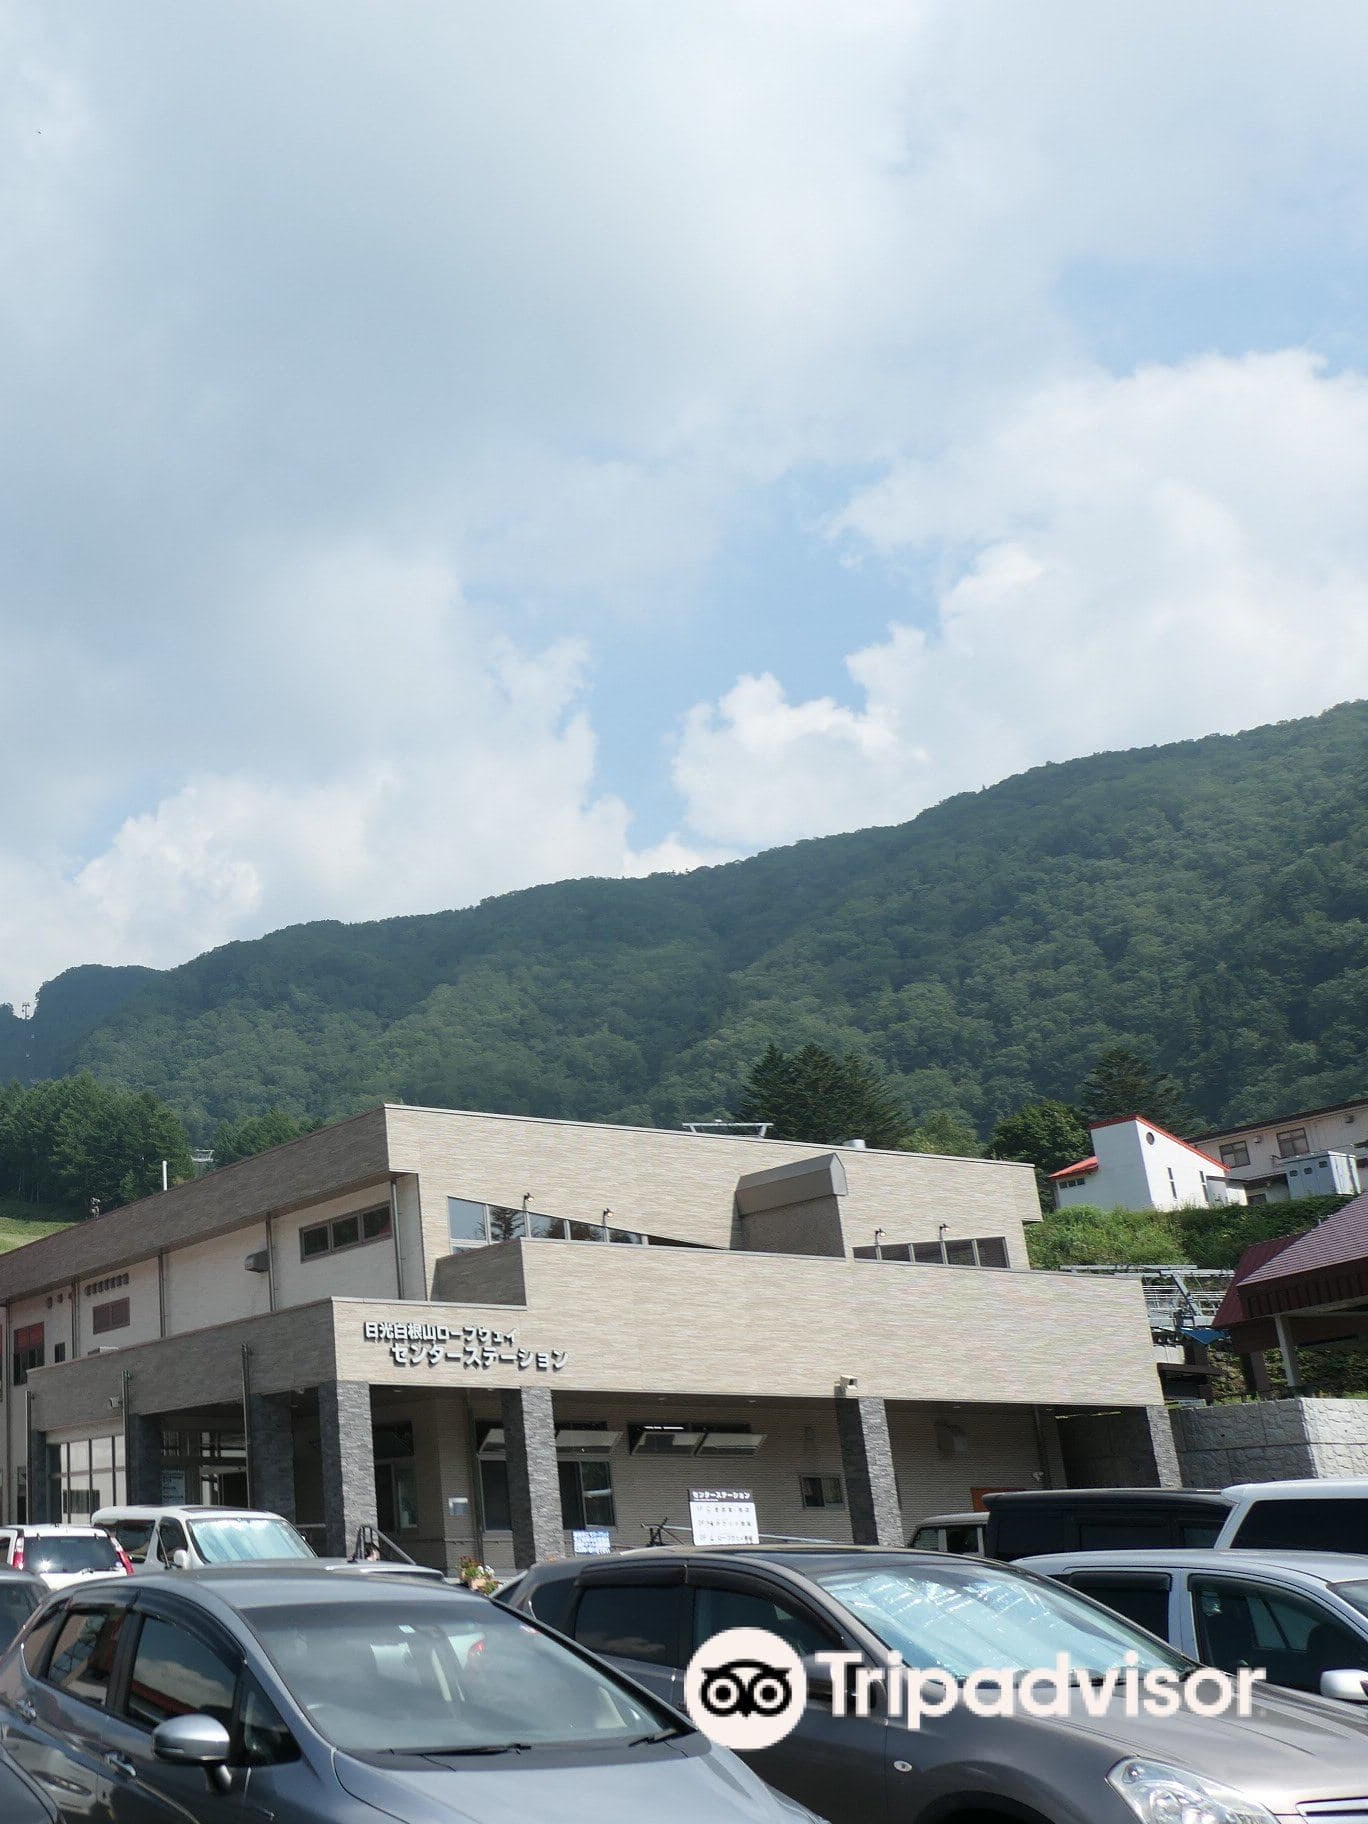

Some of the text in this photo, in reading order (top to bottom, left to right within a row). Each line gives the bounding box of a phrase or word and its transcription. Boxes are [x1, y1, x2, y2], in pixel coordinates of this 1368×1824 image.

[391, 1342, 569, 1369] センターステーション
